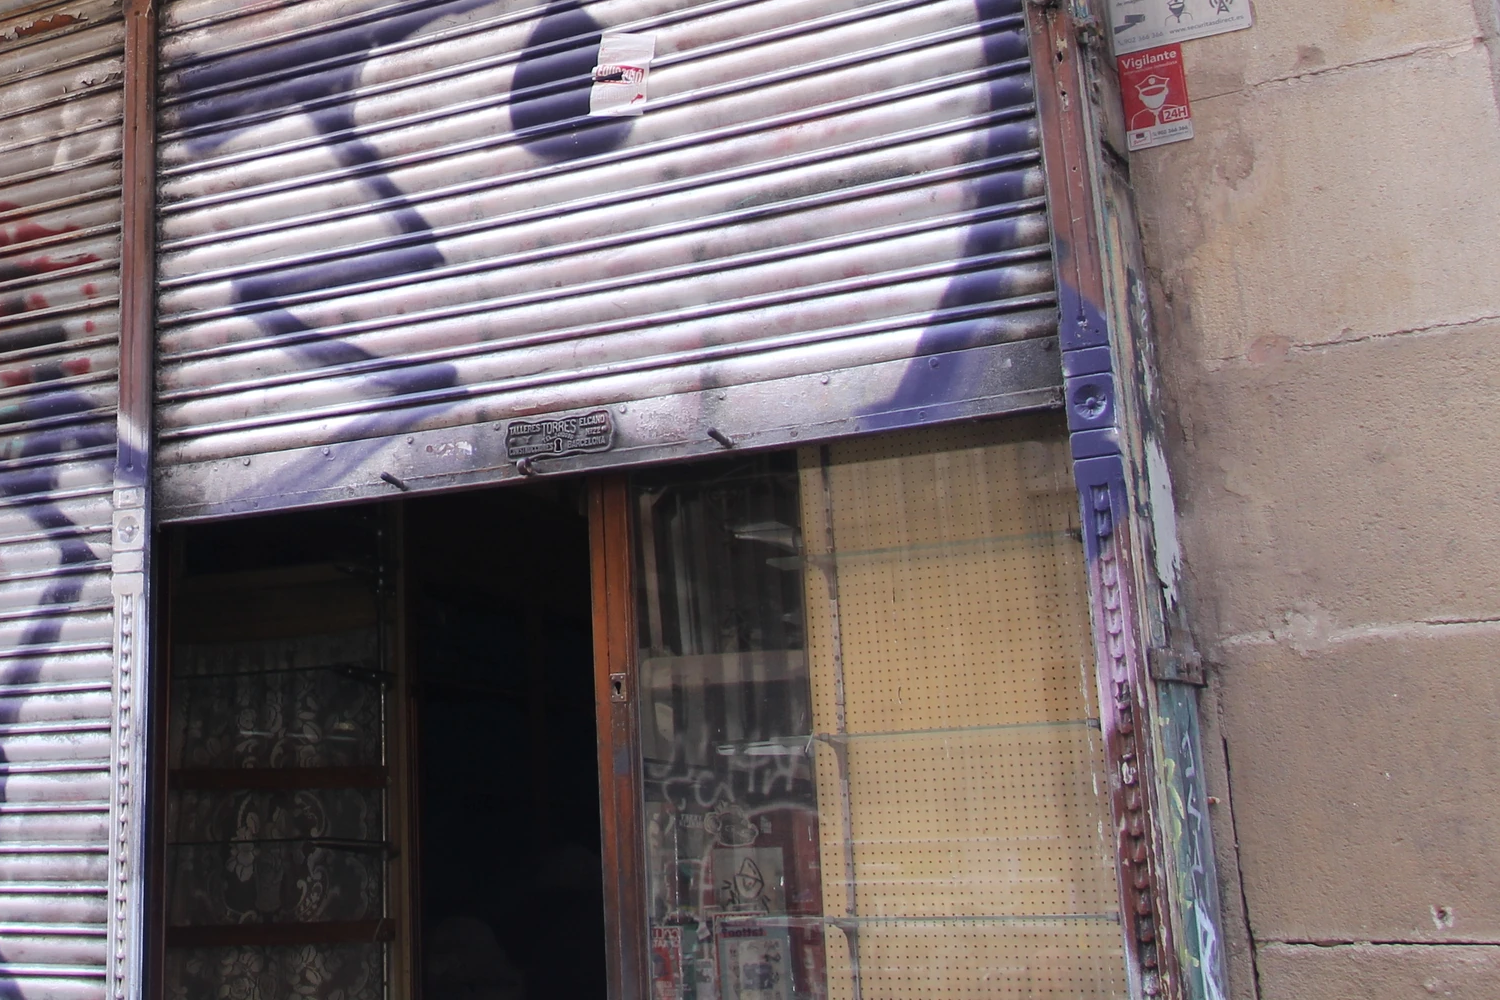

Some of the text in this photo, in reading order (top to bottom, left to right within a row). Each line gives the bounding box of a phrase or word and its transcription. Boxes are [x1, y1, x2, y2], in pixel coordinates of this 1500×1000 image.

[1122, 50, 1177, 70] Vigilante
[1164, 107, 1187, 120] 24H
[579, 414, 606, 427] ELCANO
[509, 423, 541, 436] TALLERES
[540, 418, 577, 437] TORRES
[567, 436, 606, 449] BARCELONA
